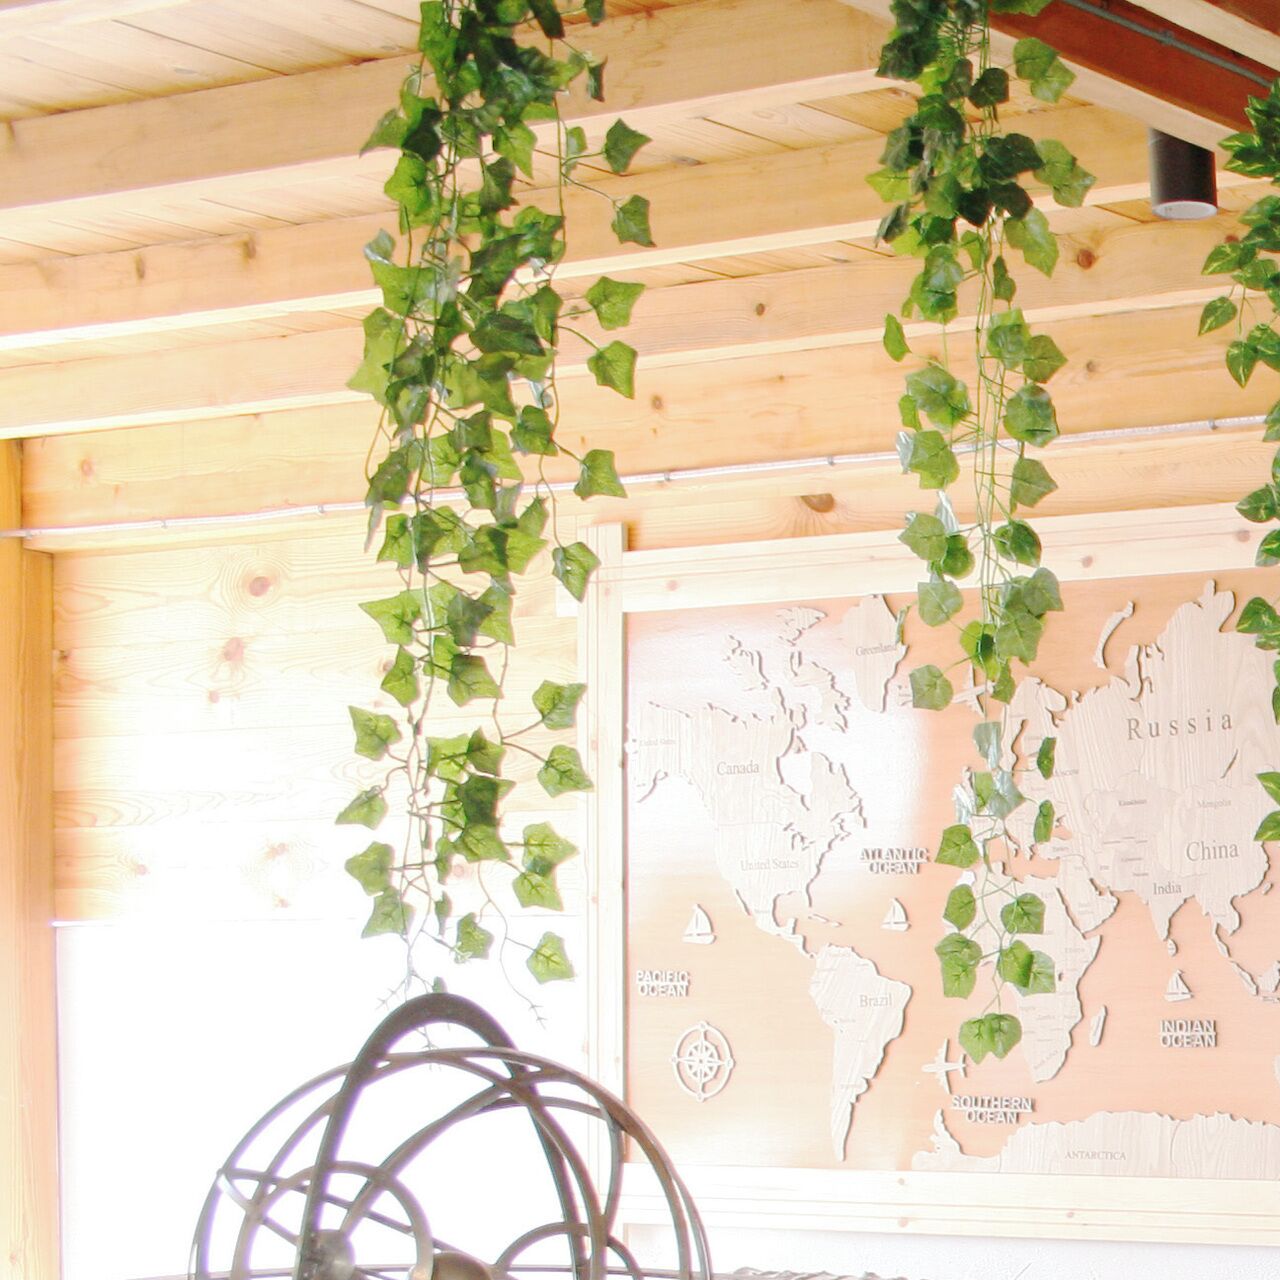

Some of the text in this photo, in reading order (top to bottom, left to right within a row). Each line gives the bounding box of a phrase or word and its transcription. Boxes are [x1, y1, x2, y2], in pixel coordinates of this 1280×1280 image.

[1127, 708, 1233, 740] Russia
[716, 759, 760, 775] Canada
[860, 847, 929, 862] ATLANTIC
[1186, 840, 1239, 862] China
[740, 857, 800, 872] United States
[868, 862, 920, 874] OCEAN
[1152, 882, 1182, 895] India
[636, 969, 690, 984] PACIFIC
[638, 983, 689, 997] OCEAN
[859, 993, 893, 1008] Brazil
[1160, 1019, 1216, 1033] INDIAN
[1160, 1034, 1217, 1048] OCEAN
[951, 1095, 1033, 1110] SOUTHERN
[966, 1110, 1018, 1124] OCEAN
[1064, 1150, 1127, 1161] ANTARCTICA
